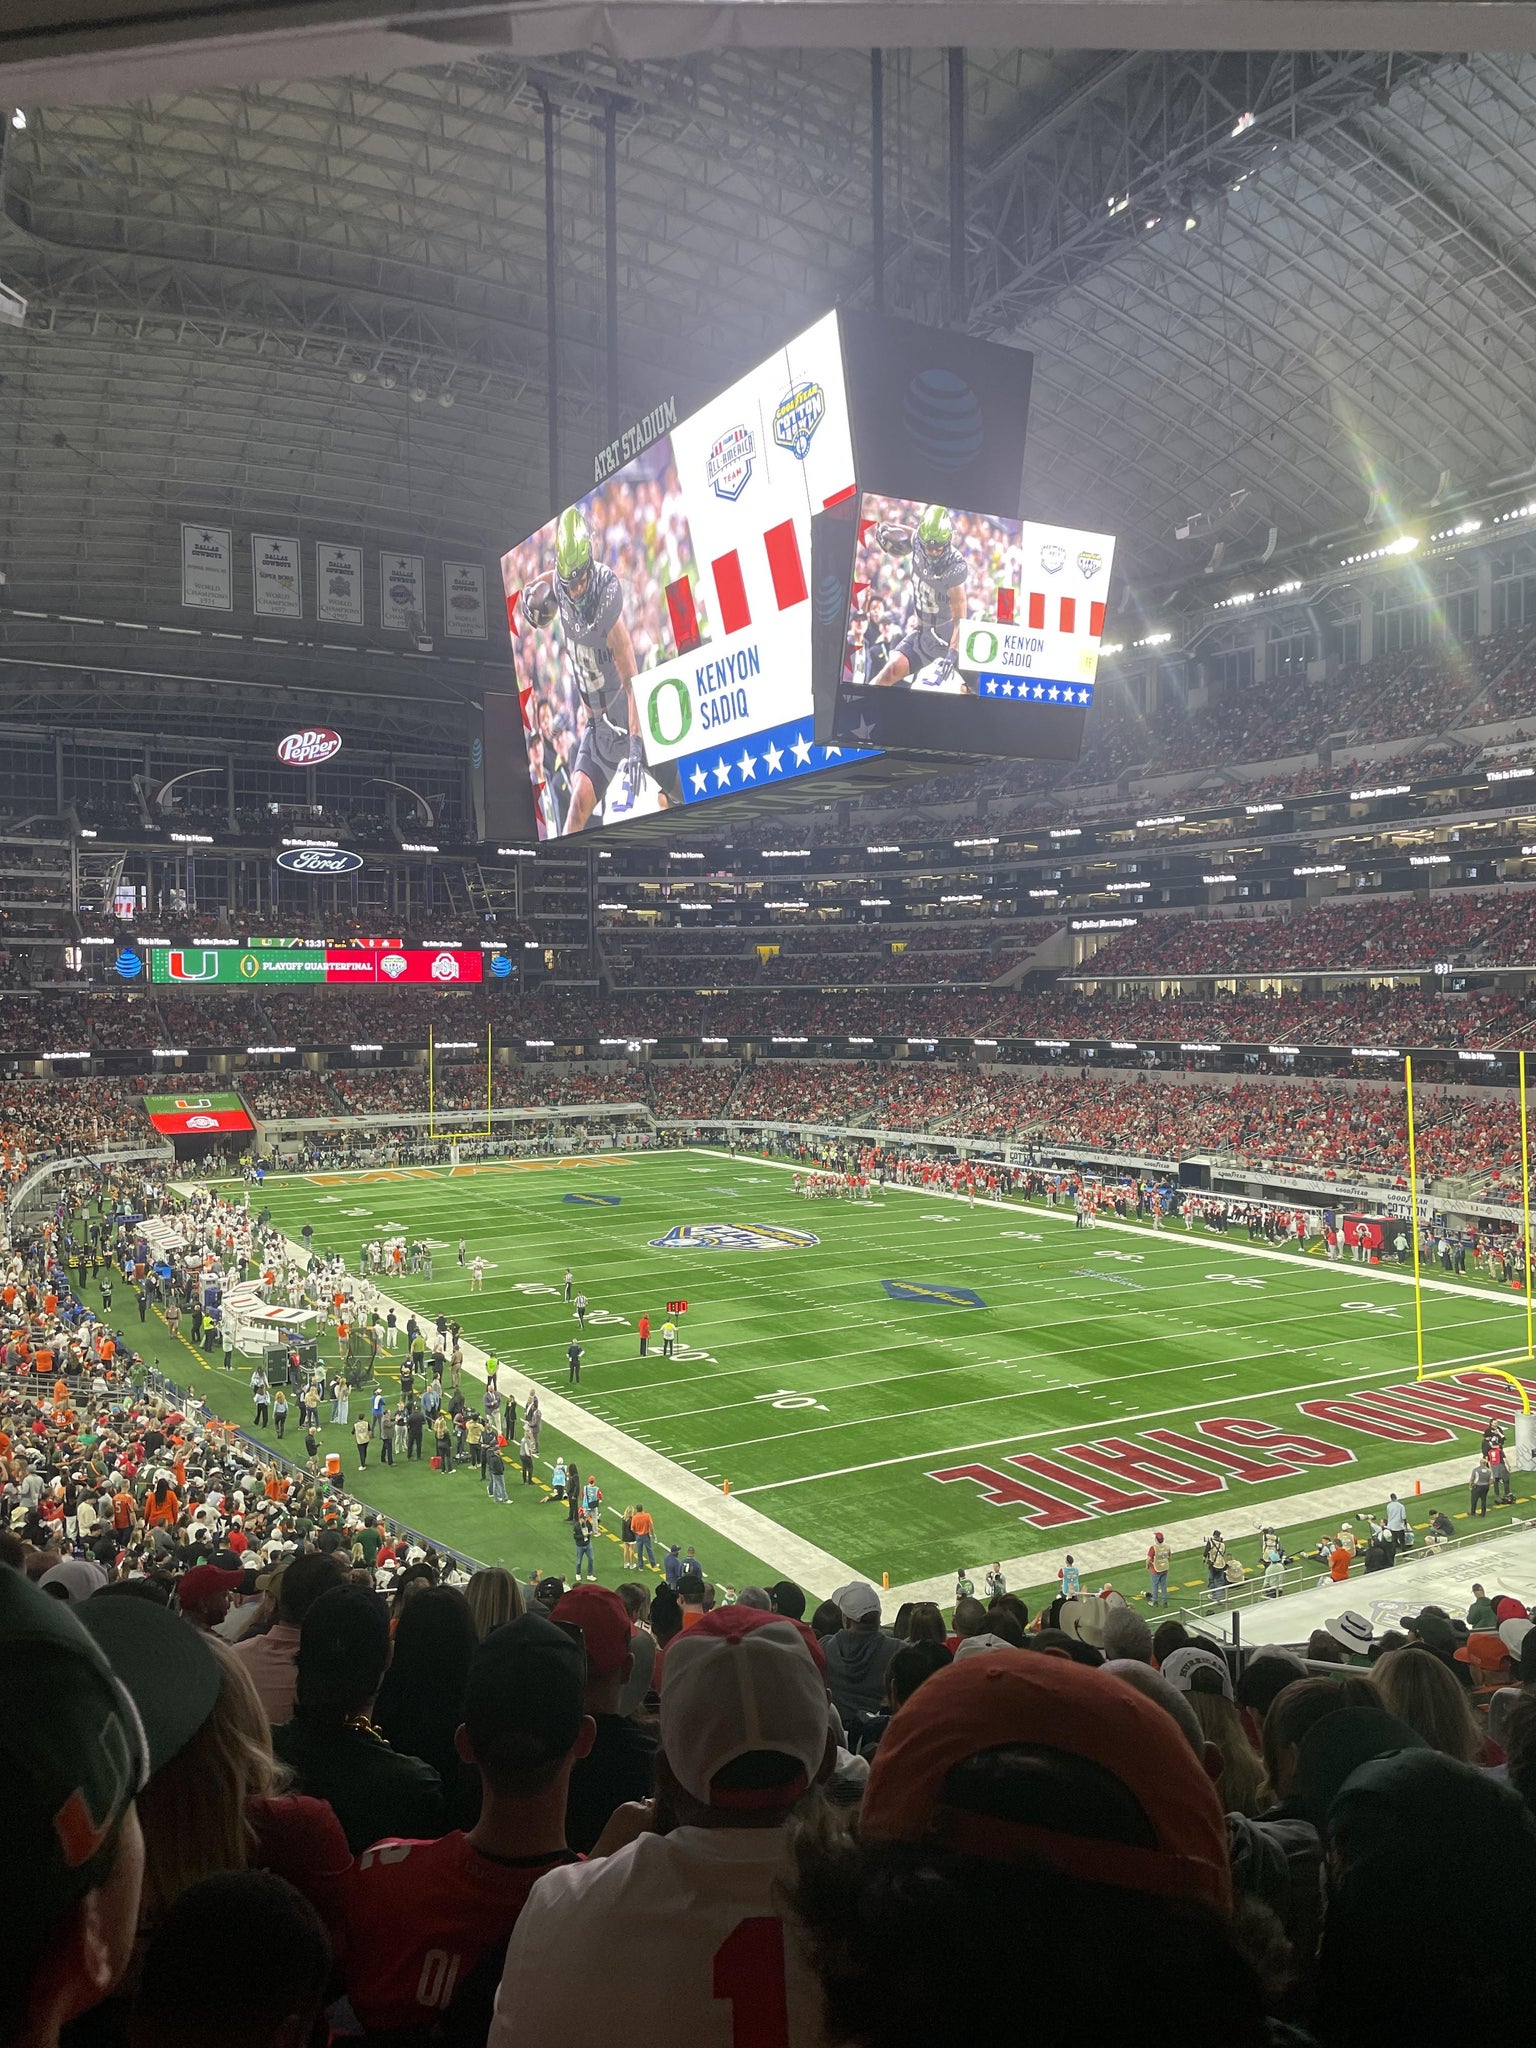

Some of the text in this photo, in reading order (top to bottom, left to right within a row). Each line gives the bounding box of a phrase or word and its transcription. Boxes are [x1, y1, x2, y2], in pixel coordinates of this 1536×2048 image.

[594, 395, 678, 482] AT&T STADIUM
[723, 467, 742, 484] TEAM
[194, 543, 219, 552] DALLAS
[191, 550, 222, 559] COWBOYS
[264, 553, 289, 561] DALLAS
[262, 560, 292, 568] COWBOYS
[966, 630, 998, 663] O
[1004, 634, 1045, 652] KENYON
[1001, 652, 1032, 668] SADIQ
[695, 644, 761, 696] KENYON
[647, 678, 692, 745] O
[700, 688, 749, 730] SADIQ
[302, 731, 326, 747] Dr
[283, 734, 338, 762] Pepper
[1486, 773, 1502, 781] This
[1509, 769, 1535, 778] Home.
[1258, 805, 1263, 813] is
[1264, 804, 1283, 812] Home.
[171, 834, 185, 842] This
[191, 835, 214, 843] Home.
[420, 845, 439, 853] Home.
[884, 846, 902, 854] Home.
[293, 850, 348, 870] Ford
[1424, 857, 1429, 865] is
[1429, 856, 1451, 864] Home.
[1203, 876, 1214, 884] This
[1219, 875, 1237, 883] Home.
[304, 939, 326, 948] 13:31
[168, 951, 373, 981] U PLAYOFF QUARTERFINAL
[1458, 1050, 1498, 1060] This is Home.
[1143, 1161, 1170, 1169] GOODYEAR
[1217, 1171, 1247, 1179] GOODYEAR
[1335, 1187, 1368, 1197] GOODYEAR
[511, 1282, 557, 1295] 40
[753, 1389, 818, 1409] 10
[924, 1416, 1358, 1531] STATE
[115, 1500, 122, 1513] 5
